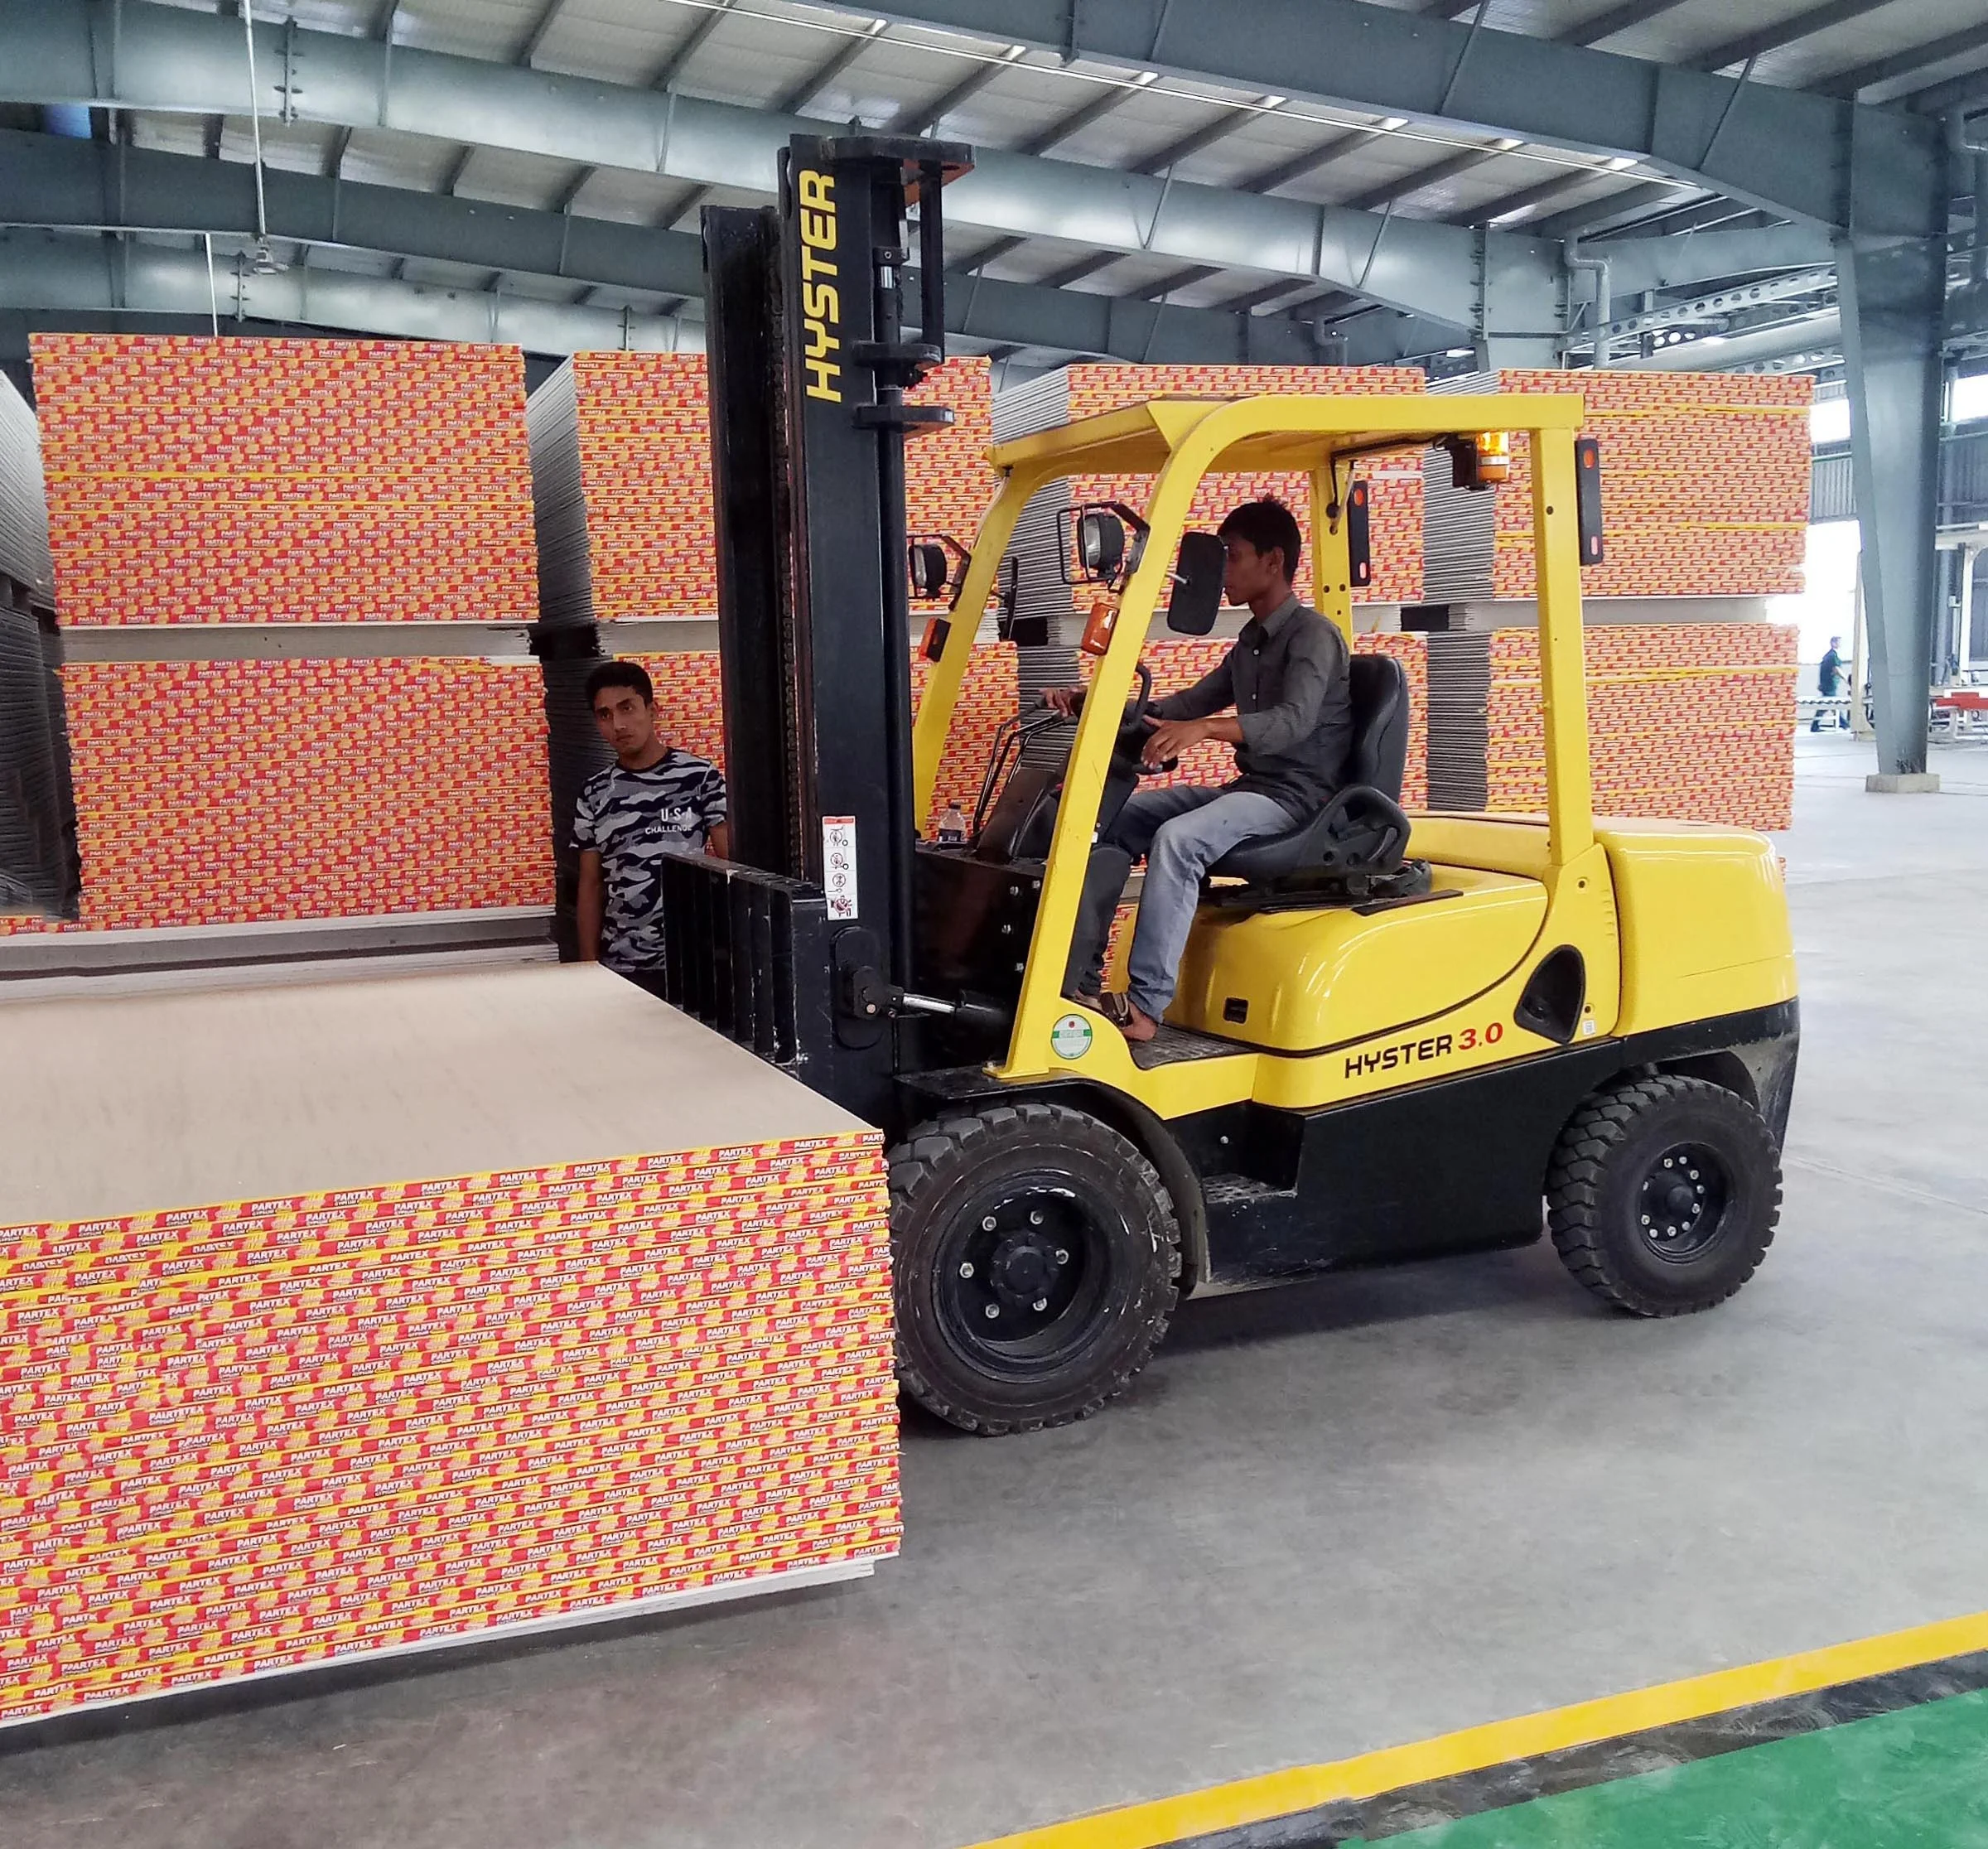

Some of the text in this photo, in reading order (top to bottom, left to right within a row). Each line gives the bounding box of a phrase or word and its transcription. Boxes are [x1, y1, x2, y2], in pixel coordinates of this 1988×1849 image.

[799, 169, 842, 403] HYSTER
[1345, 1021, 1503, 1079] HYSTER 3.0
[719, 1147, 753, 1160] PARTEX
[648, 1155, 683, 1166] PARTEX
[574, 1163, 610, 1176] PARTEX
[815, 1166, 847, 1176] PARTEX
[499, 1171, 537, 1184] PARTEX
[746, 1175, 779, 1185] PARTEX
[421, 1183, 459, 1195] PARTEX
[333, 1190, 374, 1203] PARTEX
[251, 1202, 292, 1214] PARTEX
[643, 1203, 679, 1214] PARTEX
[766, 1202, 799, 1213] PARTEX
[166, 1210, 208, 1222] PARTEX
[445, 1211, 483, 1223] PARTEX
[571, 1211, 607, 1221] PARTEX
[79, 1221, 120, 1233] PARTEX
[365, 1221, 403, 1233] PARTEX
[495, 1220, 532, 1230] PARTEX
[852, 1222, 885, 1231] PARTEX
[137, 1231, 178, 1243] PARTEX
[276, 1229, 317, 1242] PARTEX
[671, 1229, 704, 1239] PARTEX
[247, 1249, 288, 1261] PARTEX
[761, 1245, 795, 1258] PARTEX
[162, 1259, 204, 1271] PARTEX
[563, 1257, 602, 1268] PARTEX
[692, 1254, 726, 1267] PARTEX
[75, 1270, 116, 1282] PARTEX
[489, 1267, 528, 1278] PARTEX
[281, 1279, 320, 1290] PARTEX
[412, 1277, 451, 1288] PARTEX
[596, 1282, 630, 1293] PARTEX
[823, 1281, 856, 1291] PARTEX
[513, 1293, 552, 1305] PARTEX
[755, 1290, 789, 1300] PARTEX
[306, 1306, 345, 1316] PARTEX
[437, 1304, 475, 1316] PARTEX
[685, 1300, 721, 1311] PARTEX
[17, 1309, 59, 1320] PARTEX
[358, 1315, 397, 1325] PARTEX
[613, 1309, 652, 1320] PARTEX
[539, 1320, 578, 1331] PARTEX
[776, 1316, 808, 1326] PARTEX
[707, 1325, 741, 1336] PARTEX
[457, 1331, 496, 1343] PARTEX
[636, 1335, 671, 1347] PARTEX
[95, 1343, 134, 1354] PARTEX
[245, 1343, 288, 1355] PARTEX
[379, 1342, 418, 1354] PARTEX
[564, 1346, 599, 1358] PARTEX
[726, 1352, 760, 1363] PARTEX
[844, 1349, 878, 1359] PARTEX
[488, 1358, 525, 1370] PARTEX
[656, 1364, 691, 1373] PARTEX
[20, 1364, 61, 1376] PARTEX
[269, 1371, 312, 1383] PARTEX
[404, 1371, 442, 1383] PARTEX
[583, 1373, 620, 1383] PARTEX
[753, 1377, 787, 1387] PARTEX
[194, 1386, 233, 1397] PARTEX
[324, 1383, 363, 1394] PARTEX
[676, 1388, 712, 1399] PARTEX
[482, 1403, 521, 1415] PARTEX
[772, 1402, 808, 1412] PARTEX
[14, 1412, 55, 1424] PARTEX
[347, 1409, 386, 1420] PARTEX
[704, 1414, 738, 1424] PARTEX
[405, 1417, 443, 1429] PARTEX
[579, 1418, 615, 1429] PARTEX
[861, 1418, 893, 1427] PARTEX
[504, 1429, 543, 1441] PARTEX
[793, 1427, 827, 1437] PARTEX
[39, 1441, 80, 1454] PARTEX
[239, 1440, 279, 1451] PARTEX
[428, 1441, 467, 1453] PARTEX
[724, 1438, 760, 1449] PARTEX
[350, 1453, 390, 1465] PARTEX
[528, 1453, 566, 1465] PARTEX
[654, 1451, 688, 1460] PARTEX
[745, 1464, 779, 1474] PARTEX
[856, 1460, 888, 1470] PARTEX
[263, 1469, 302, 1480] PARTEX
[452, 1466, 490, 1477] PARTEX
[179, 1482, 220, 1494] PARTEX
[374, 1479, 415, 1490] PARTEX
[550, 1480, 588, 1491] PARTEX
[475, 1492, 514, 1504] PARTEX
[765, 1488, 799, 1498] PARTEX
[650, 1494, 687, 1504] PARTEX
[204, 1507, 247, 1519] PARTEX
[348, 1503, 387, 1515] PARTEX
[448, 1515, 485, 1526] PARTEX
[786, 1514, 818, 1523] PARTEX
[370, 1524, 411, 1537] PARTEX
[552, 1525, 589, 1536] PARTEX
[672, 1520, 707, 1530] PARTEX
[291, 1538, 331, 1551] PARTEX
[471, 1538, 509, 1549] PARTEX
[145, 1548, 188, 1562] PARTEX
[738, 1551, 772, 1561] PARTEX
[4, 1558, 43, 1569] PARTEX
[445, 1561, 482, 1571] PARTEX
[622, 1557, 659, 1567] PARTEX
[315, 1565, 355, 1577] PARTEX
[550, 1570, 586, 1581] PARTEX
[475, 1584, 512, 1595] PARTEX
[87, 1590, 130, 1602] PARTEX
[206, 1600, 247, 1613] PARTEX
[391, 1596, 432, 1609] PARTEX
[312, 1610, 353, 1623] PARTEX
[230, 1625, 273, 1639] PARTEX
[148, 1641, 191, 1654] PARTEX
